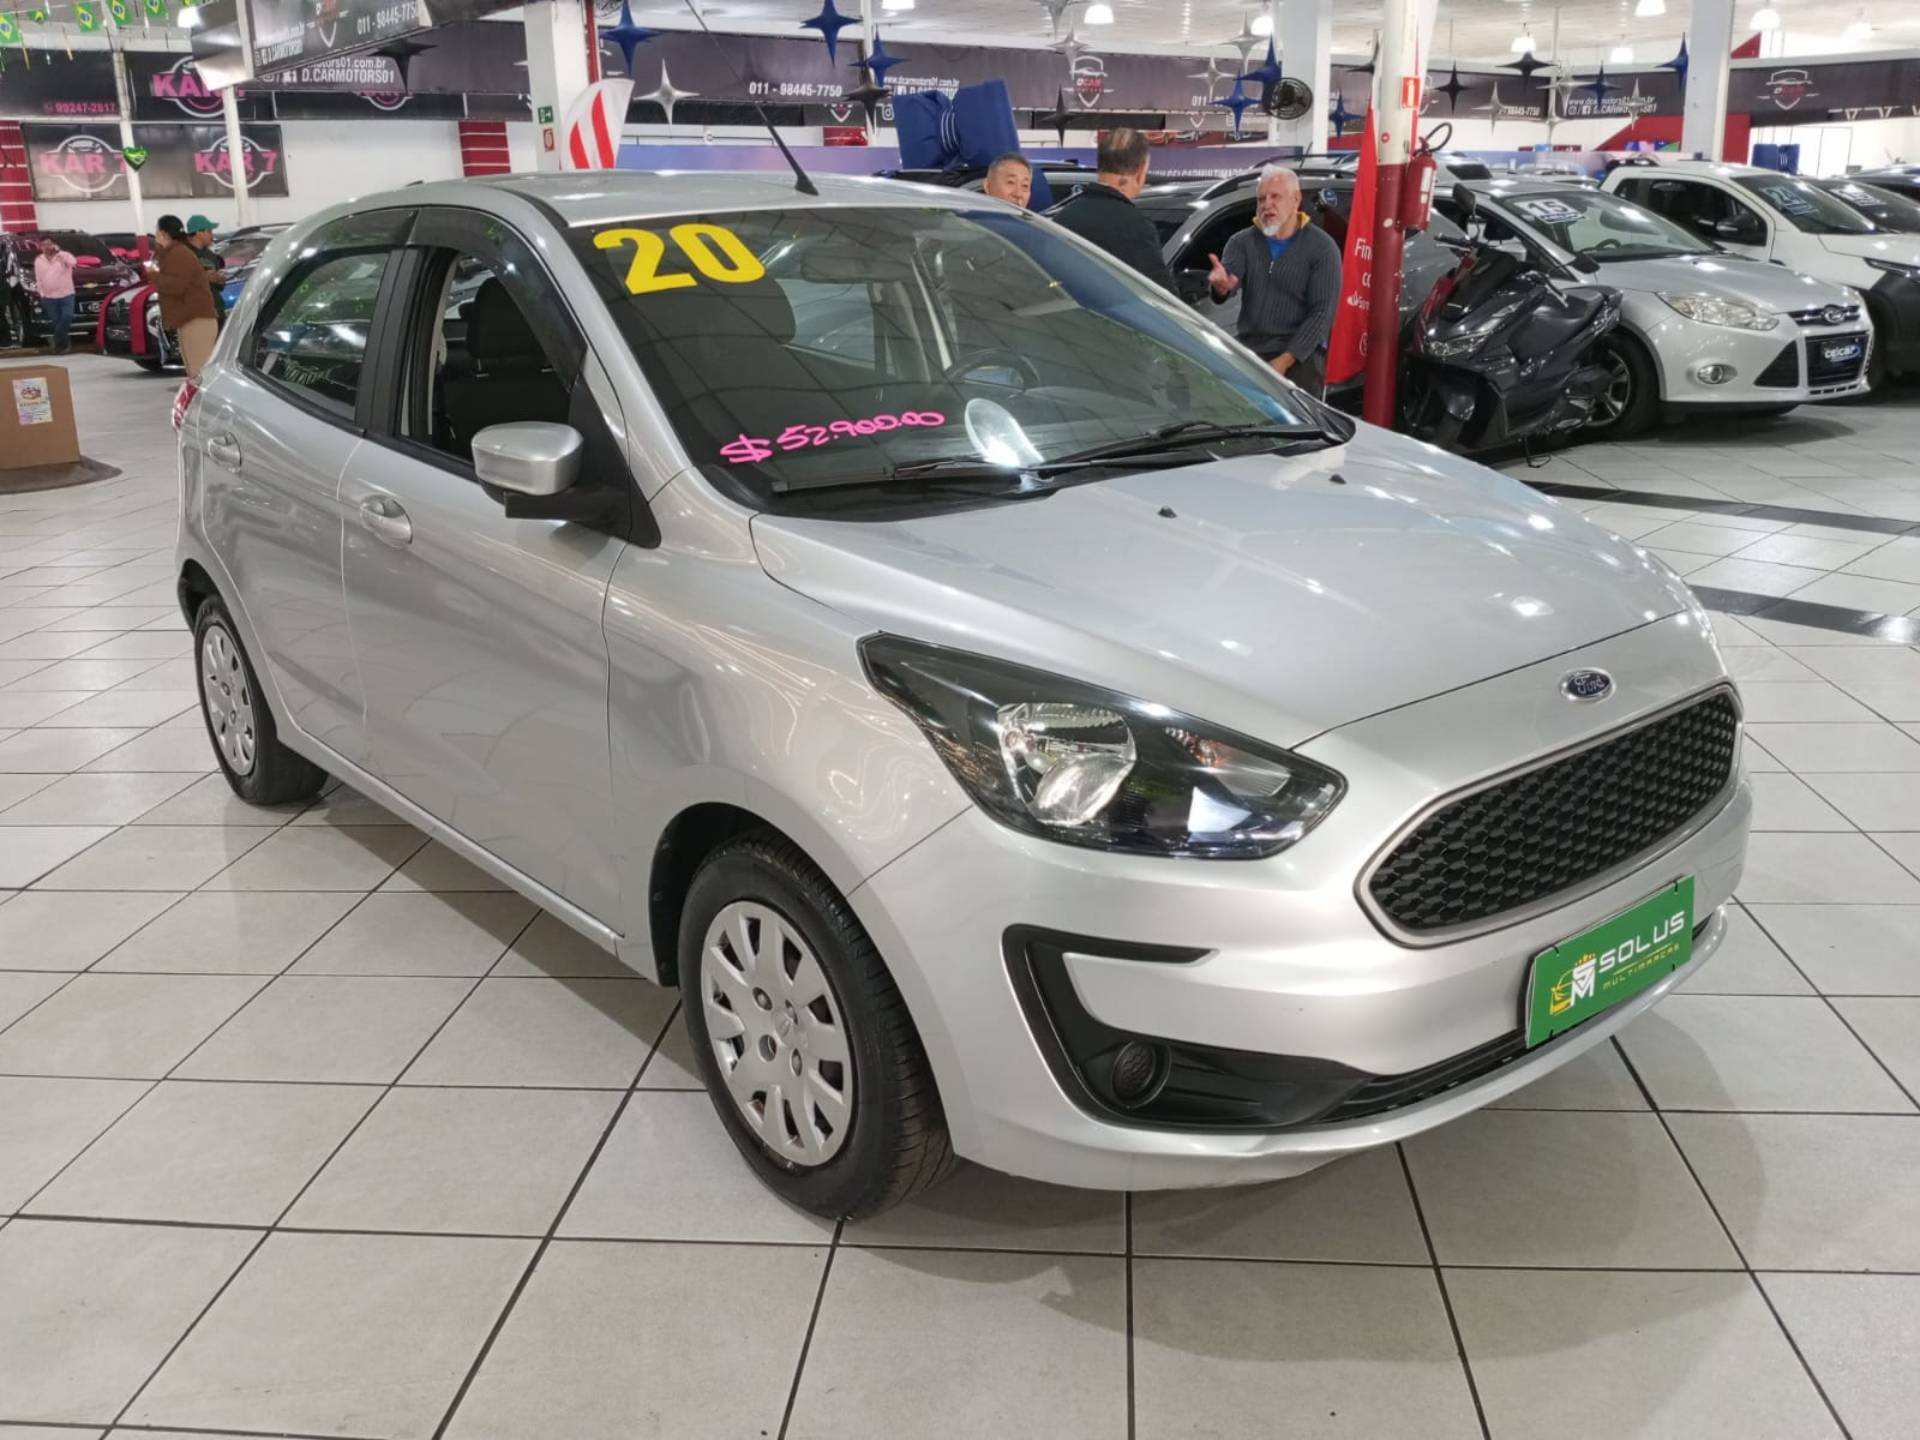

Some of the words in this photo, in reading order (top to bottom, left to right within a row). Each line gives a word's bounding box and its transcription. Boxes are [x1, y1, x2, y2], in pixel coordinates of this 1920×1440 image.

[357, 16, 371, 34] 011
[301, 67, 395, 83] D.CARMOTORS01
[749, 81, 769, 95] 011
[780, 82, 843, 97] 98445-7750
[261, 152, 277, 172] 7
[593, 223, 766, 295] 20
[1598, 910, 1685, 973] SOLUS
